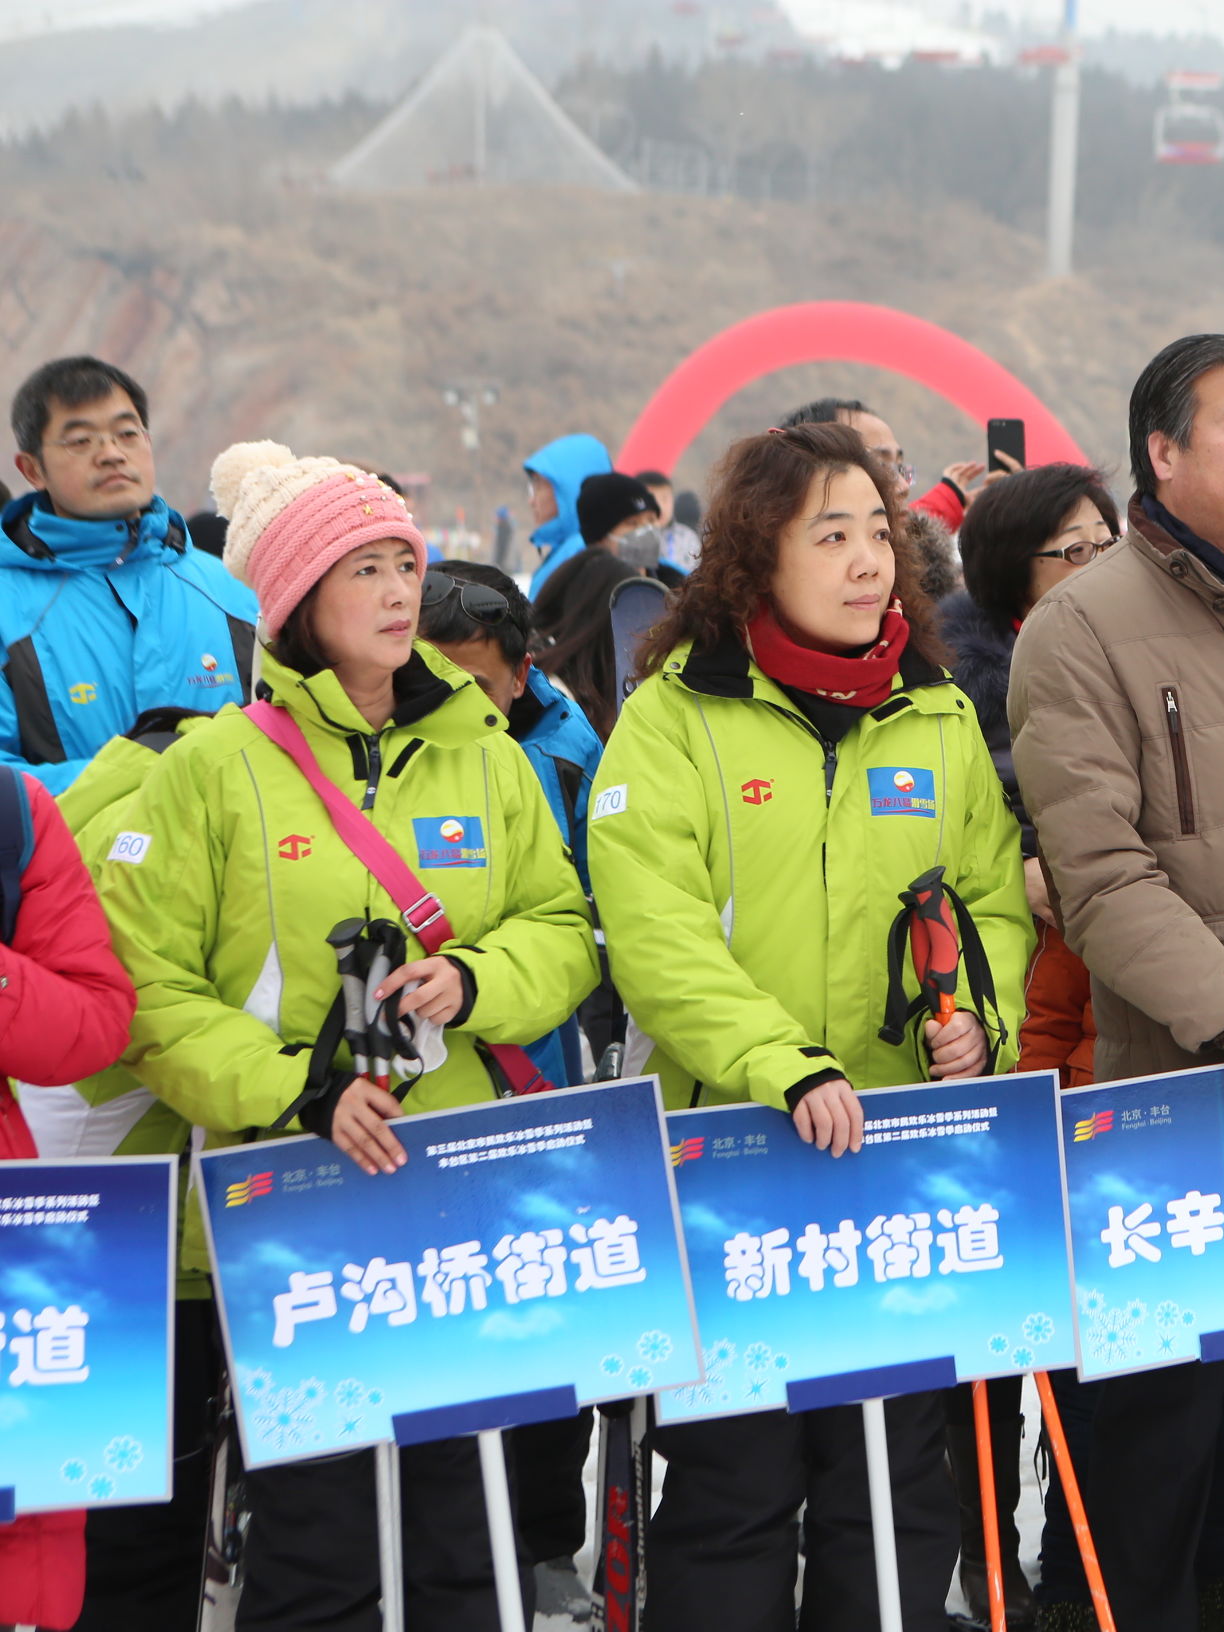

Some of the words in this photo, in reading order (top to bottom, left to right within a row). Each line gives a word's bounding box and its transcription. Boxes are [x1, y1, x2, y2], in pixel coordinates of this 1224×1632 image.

[596, 790, 621, 814] 170
[862, 1107, 998, 1131] 届北京市民欢乐冰雪季系列活动暨
[272, 1215, 647, 1348] 卢沟桥街道
[723, 1203, 1004, 1302] 新村街道
[0, 1304, 90, 1387] 道
